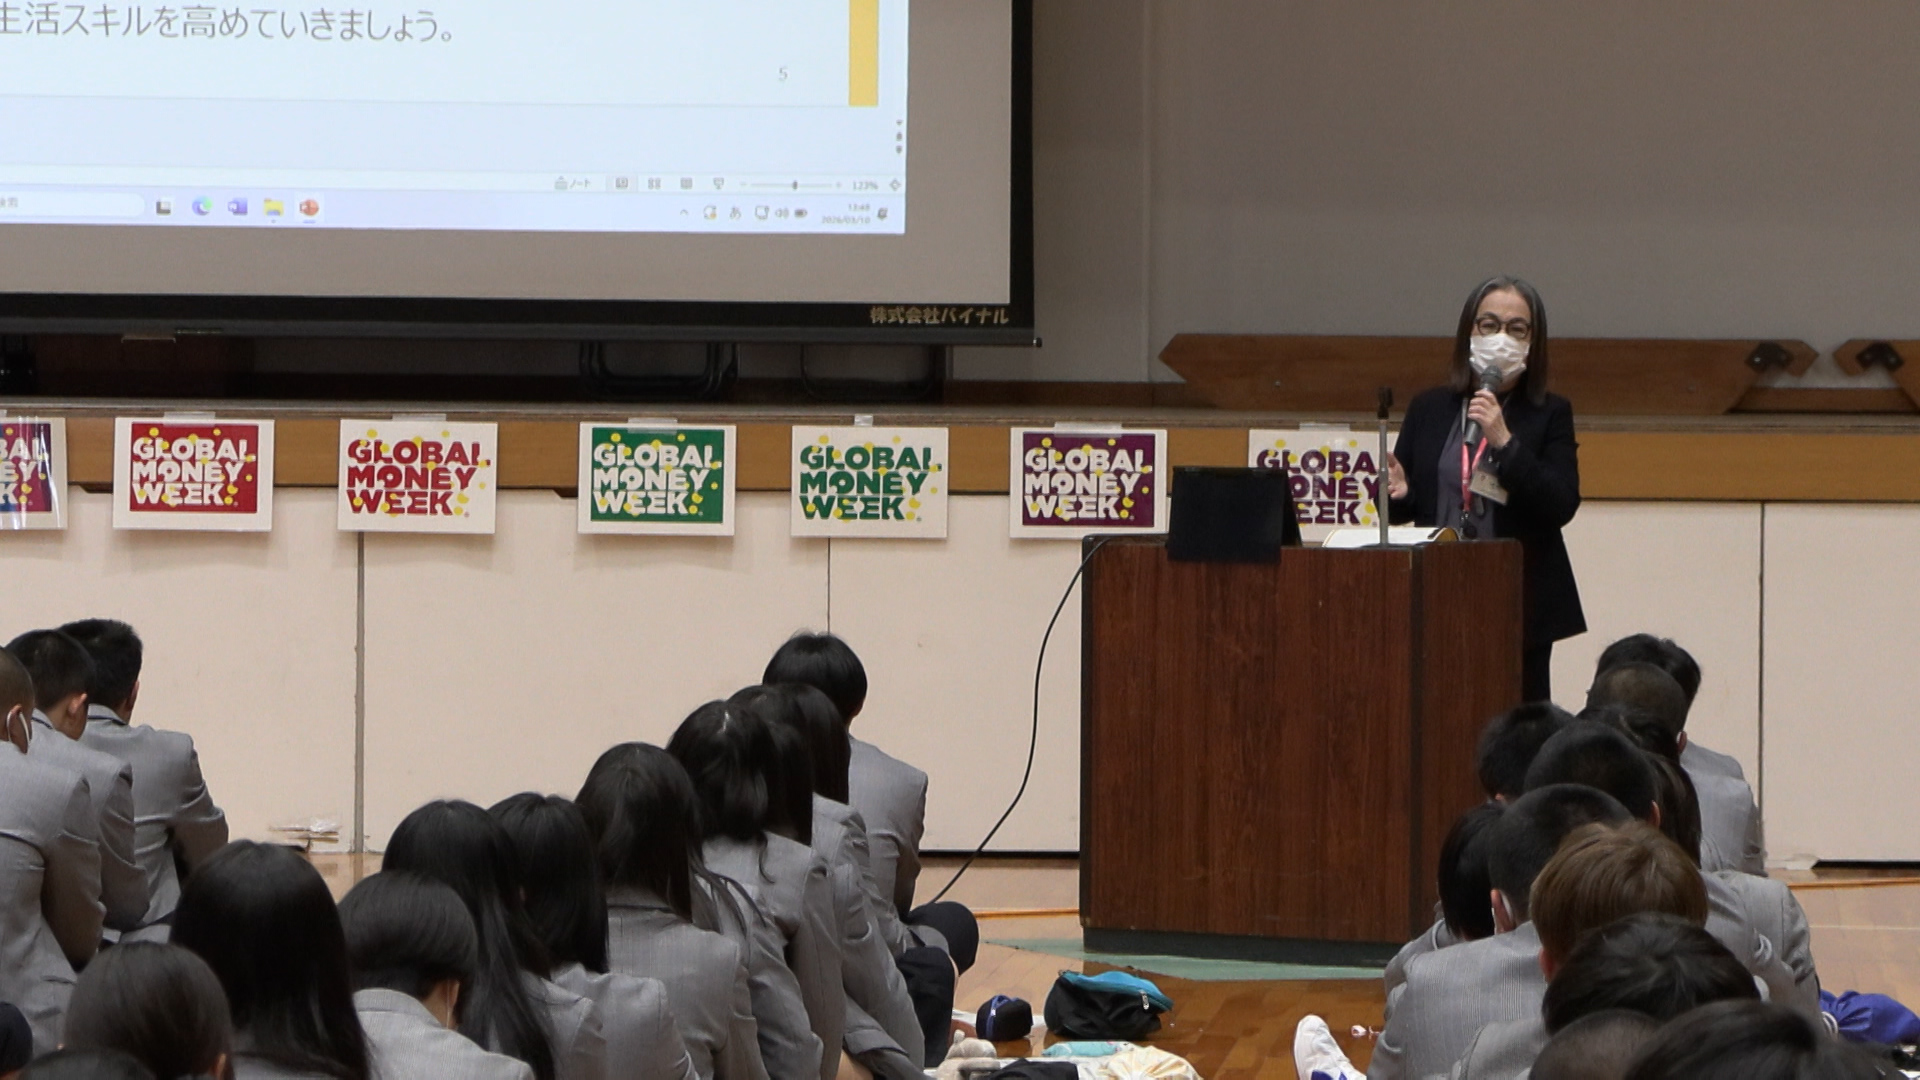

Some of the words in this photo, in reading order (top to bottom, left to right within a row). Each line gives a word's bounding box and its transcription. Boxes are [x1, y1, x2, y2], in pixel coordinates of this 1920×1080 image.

[0, 1, 452, 42] 生活スキルを高めていきましょう。
[778, 65, 789, 82] 5
[729, 207, 742, 220] あ
[870, 305, 1009, 325] 株式会社バイナル
[132, 437, 257, 462] GLOBAL
[347, 439, 491, 466] GLOBAL
[593, 442, 723, 469] GLOBAL
[799, 445, 943, 471] GLOBAL
[1024, 447, 1153, 473] GLOBAL
[1256, 448, 1379, 476] GLOBA
[132, 459, 245, 483] MONEY
[347, 464, 477, 491] MONEY
[593, 466, 710, 492] MONEY
[799, 470, 929, 496] MONEY
[1024, 471, 1141, 496] MONEY
[131, 481, 225, 506] WEEK
[1287, 474, 1380, 500] ONEY
[346, 488, 454, 516] WEEK
[592, 489, 689, 516] WEEK
[799, 495, 905, 521] WEEK
[1023, 494, 1120, 520] WEEK
[1294, 500, 1362, 526] EEK
